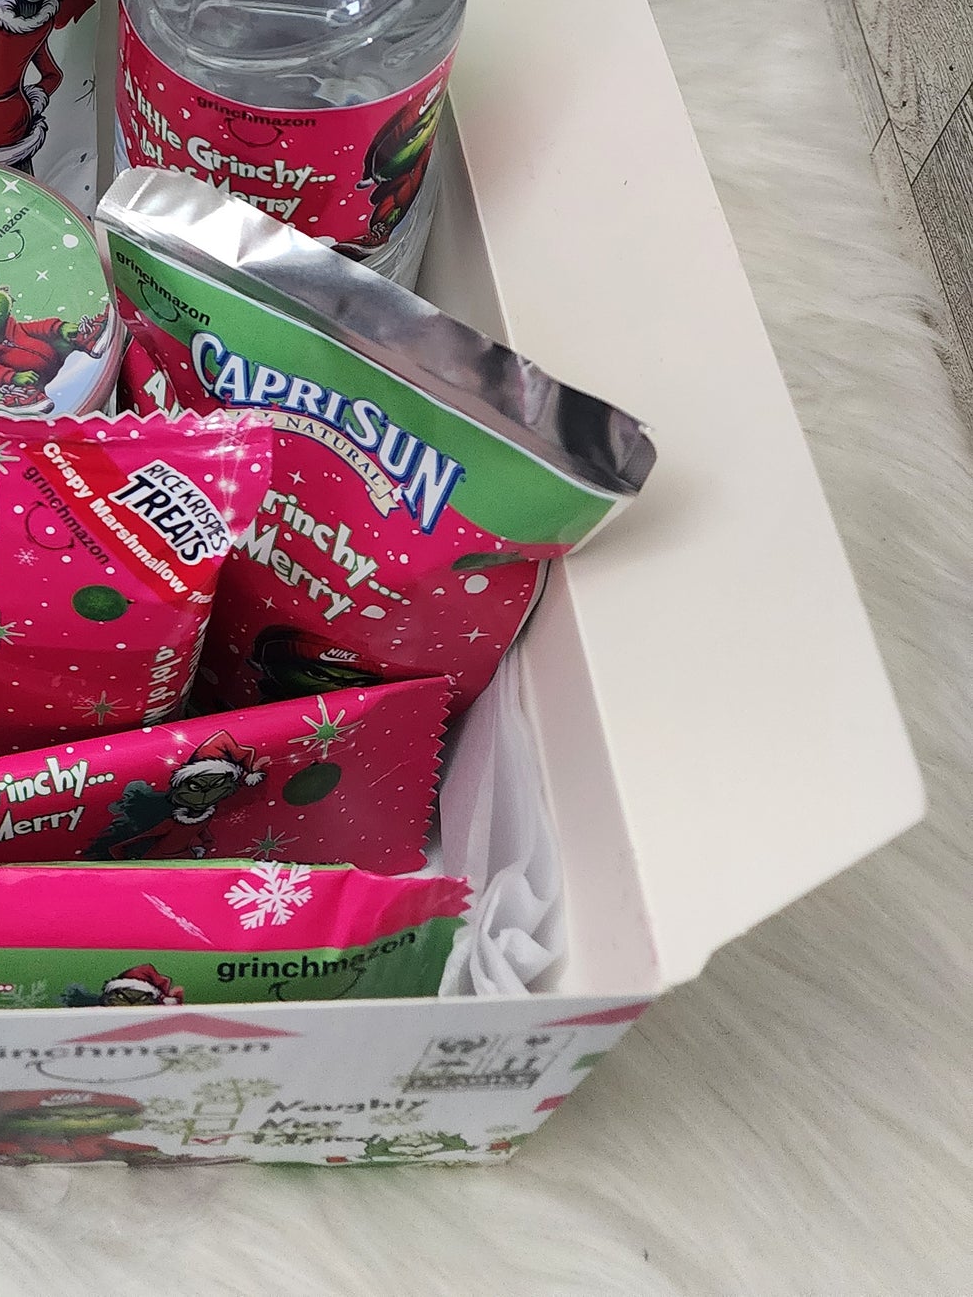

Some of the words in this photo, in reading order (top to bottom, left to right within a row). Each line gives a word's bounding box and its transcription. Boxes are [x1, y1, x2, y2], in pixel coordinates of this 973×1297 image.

[124, 66, 136, 102] A
[136, 88, 182, 150] little
[140, 126, 164, 165] lot
[196, 95, 317, 128] grinchmazon
[115, 250, 211, 326] grinchmazon
[143, 463, 189, 493] RICE
[285, 415, 384, 487] NATURAL
[24, 466, 112, 566] grinchmazon
[42, 442, 95, 499] Crispy
[89, 498, 188, 594] Marshmallow
[114, 474, 209, 561] TREATS
[261, 486, 413, 606] rinchy...
[234, 518, 356, 621] Merry
[326, 647, 360, 662] NIKE
[217, 929, 416, 984] grinchmazon
